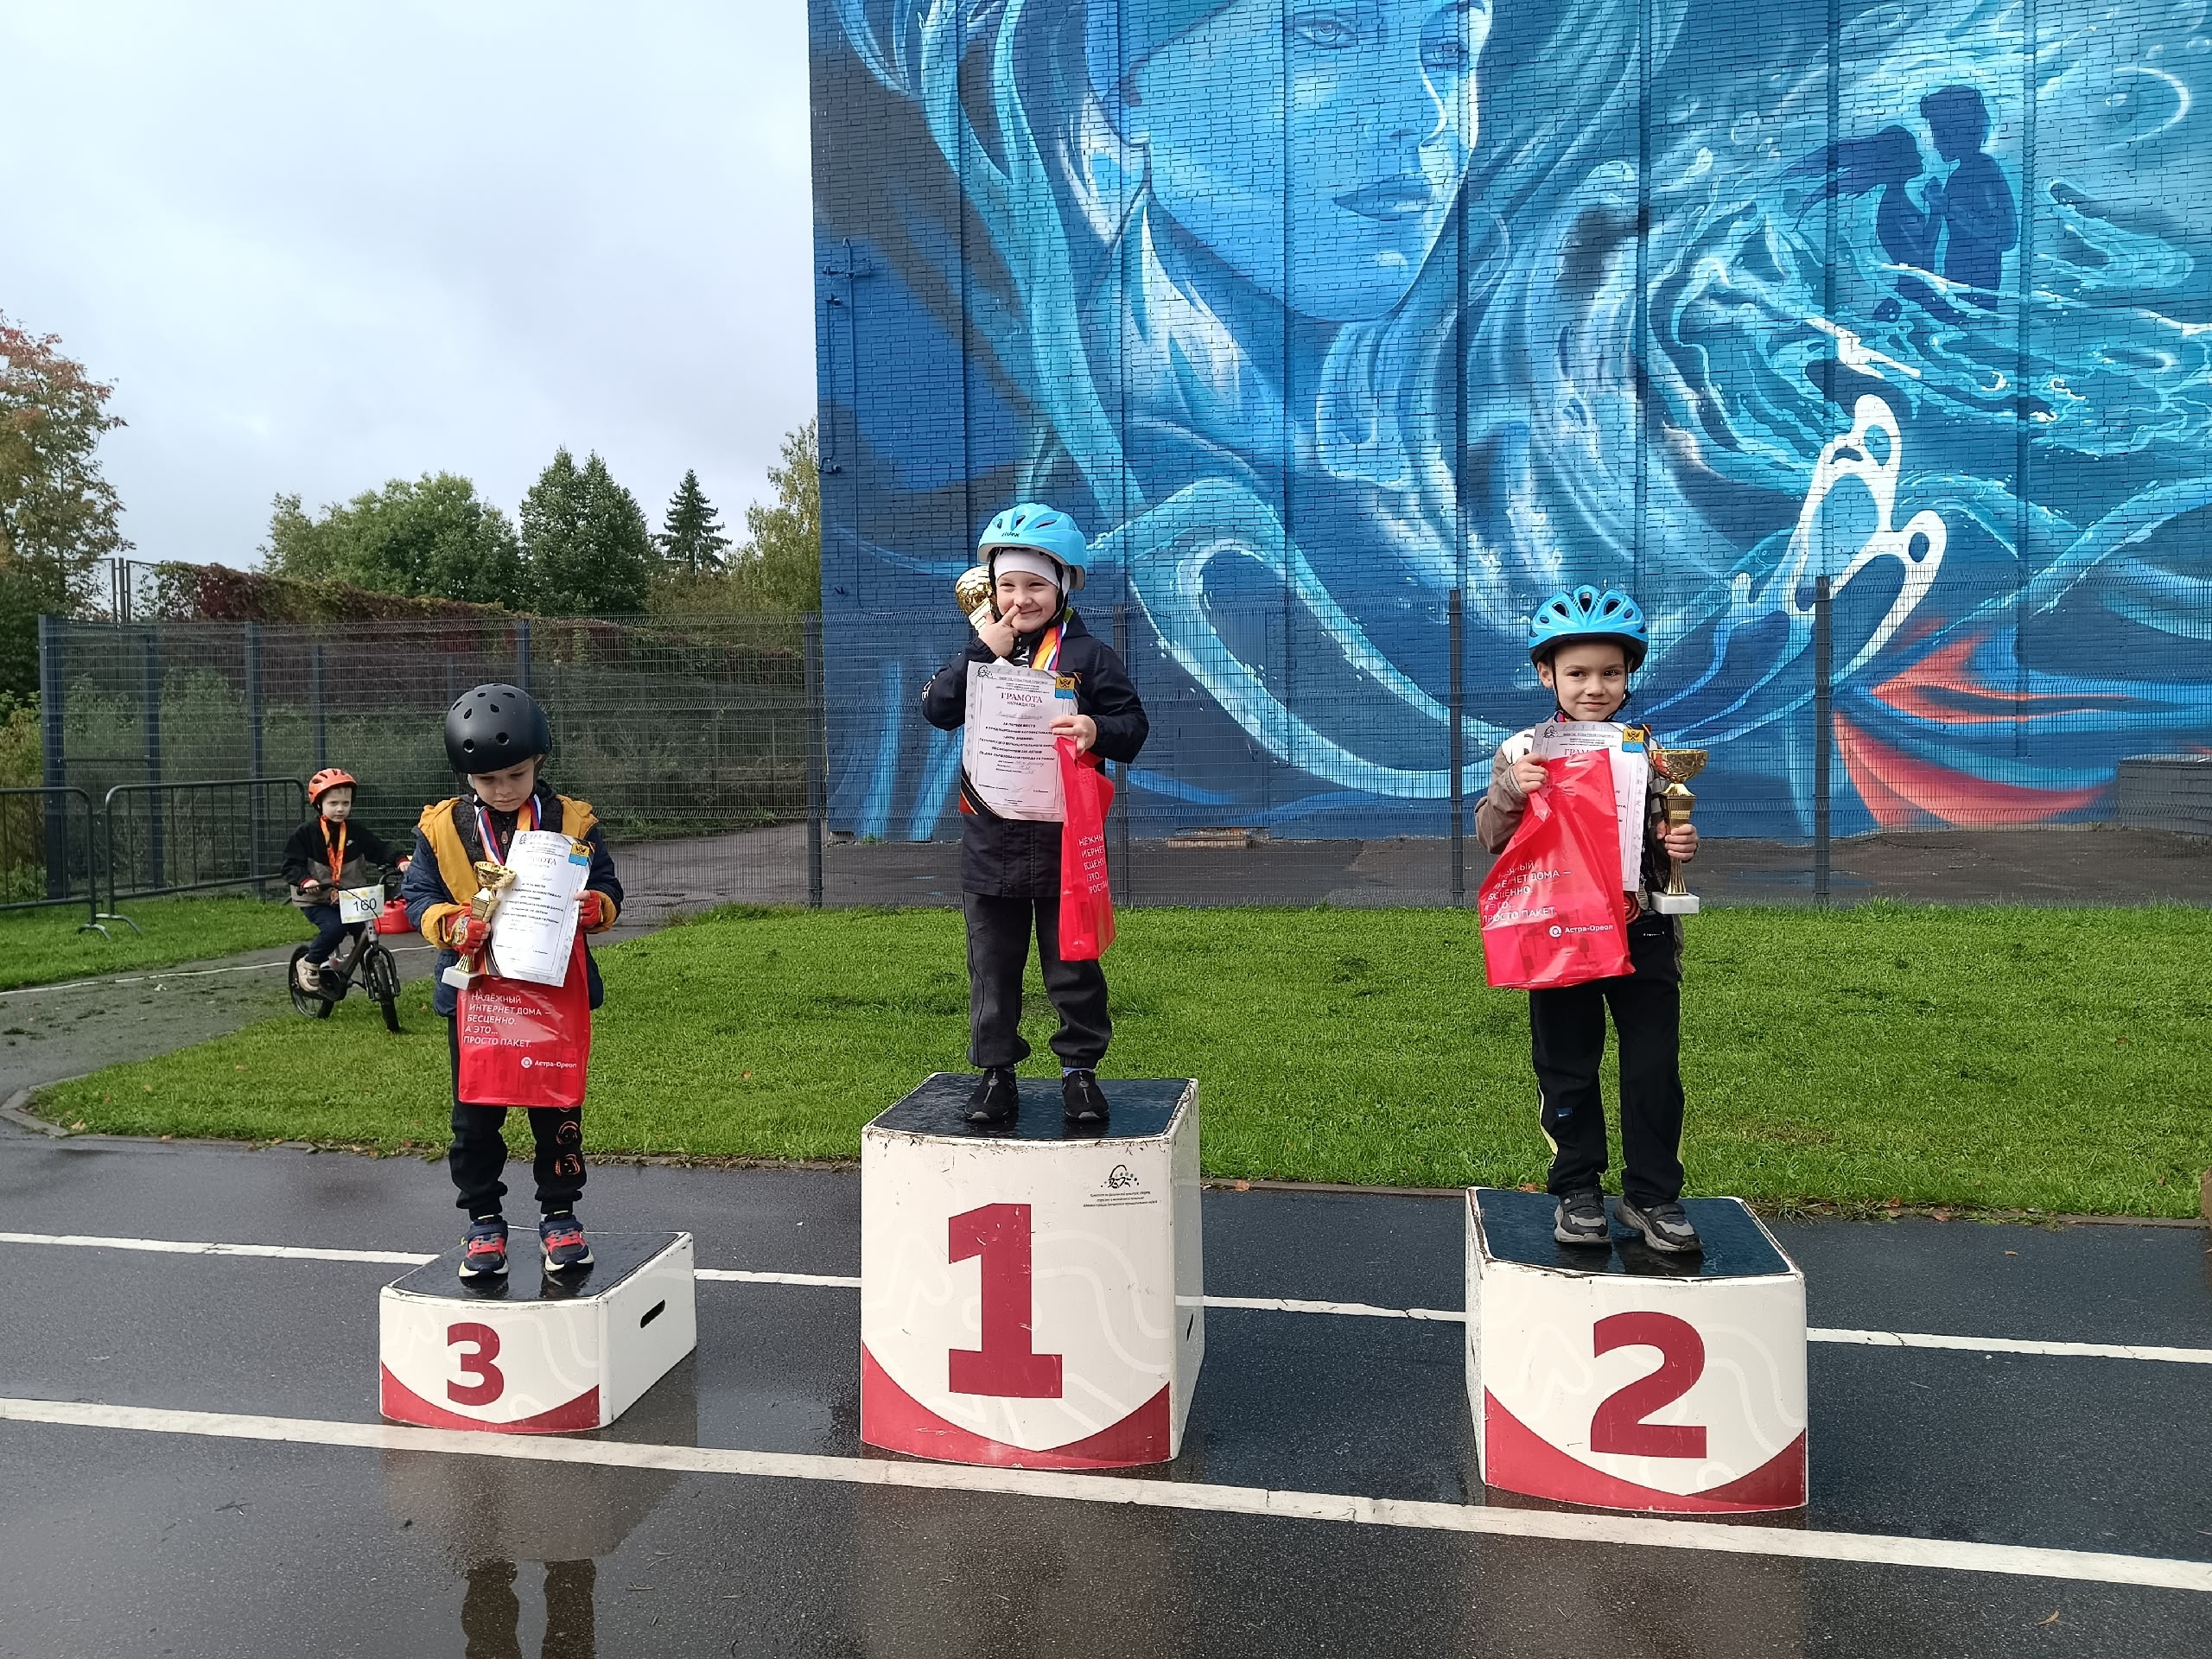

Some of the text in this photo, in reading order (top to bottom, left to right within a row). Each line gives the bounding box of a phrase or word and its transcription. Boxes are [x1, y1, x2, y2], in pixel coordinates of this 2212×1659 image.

[1001, 692, 1043, 703] ГРАМОТА
[1531, 870, 1560, 881] ДОМА
[353, 898, 377, 912] 160
[1482, 906, 1558, 923] ПРОСТО ПАКЕТ.
[1565, 925, 1613, 933] Астра-Ореол
[471, 992, 522, 1004] НАДЁЖНЫЙ
[468, 1003, 515, 1014] ИНТЕРНЕТ
[516, 1007, 543, 1016] ДОМА
[467, 1014, 517, 1026] БЕСЦЕННО.
[473, 1025, 499, 1034] ЭТО...
[463, 1036, 531, 1048] ПРОСТО ПАКЕТ.
[534, 1059, 577, 1069] Астра-Ореол
[949, 1203, 1063, 1398] 1
[447, 1322, 504, 1406] 3
[1591, 1312, 1707, 1459] 2
